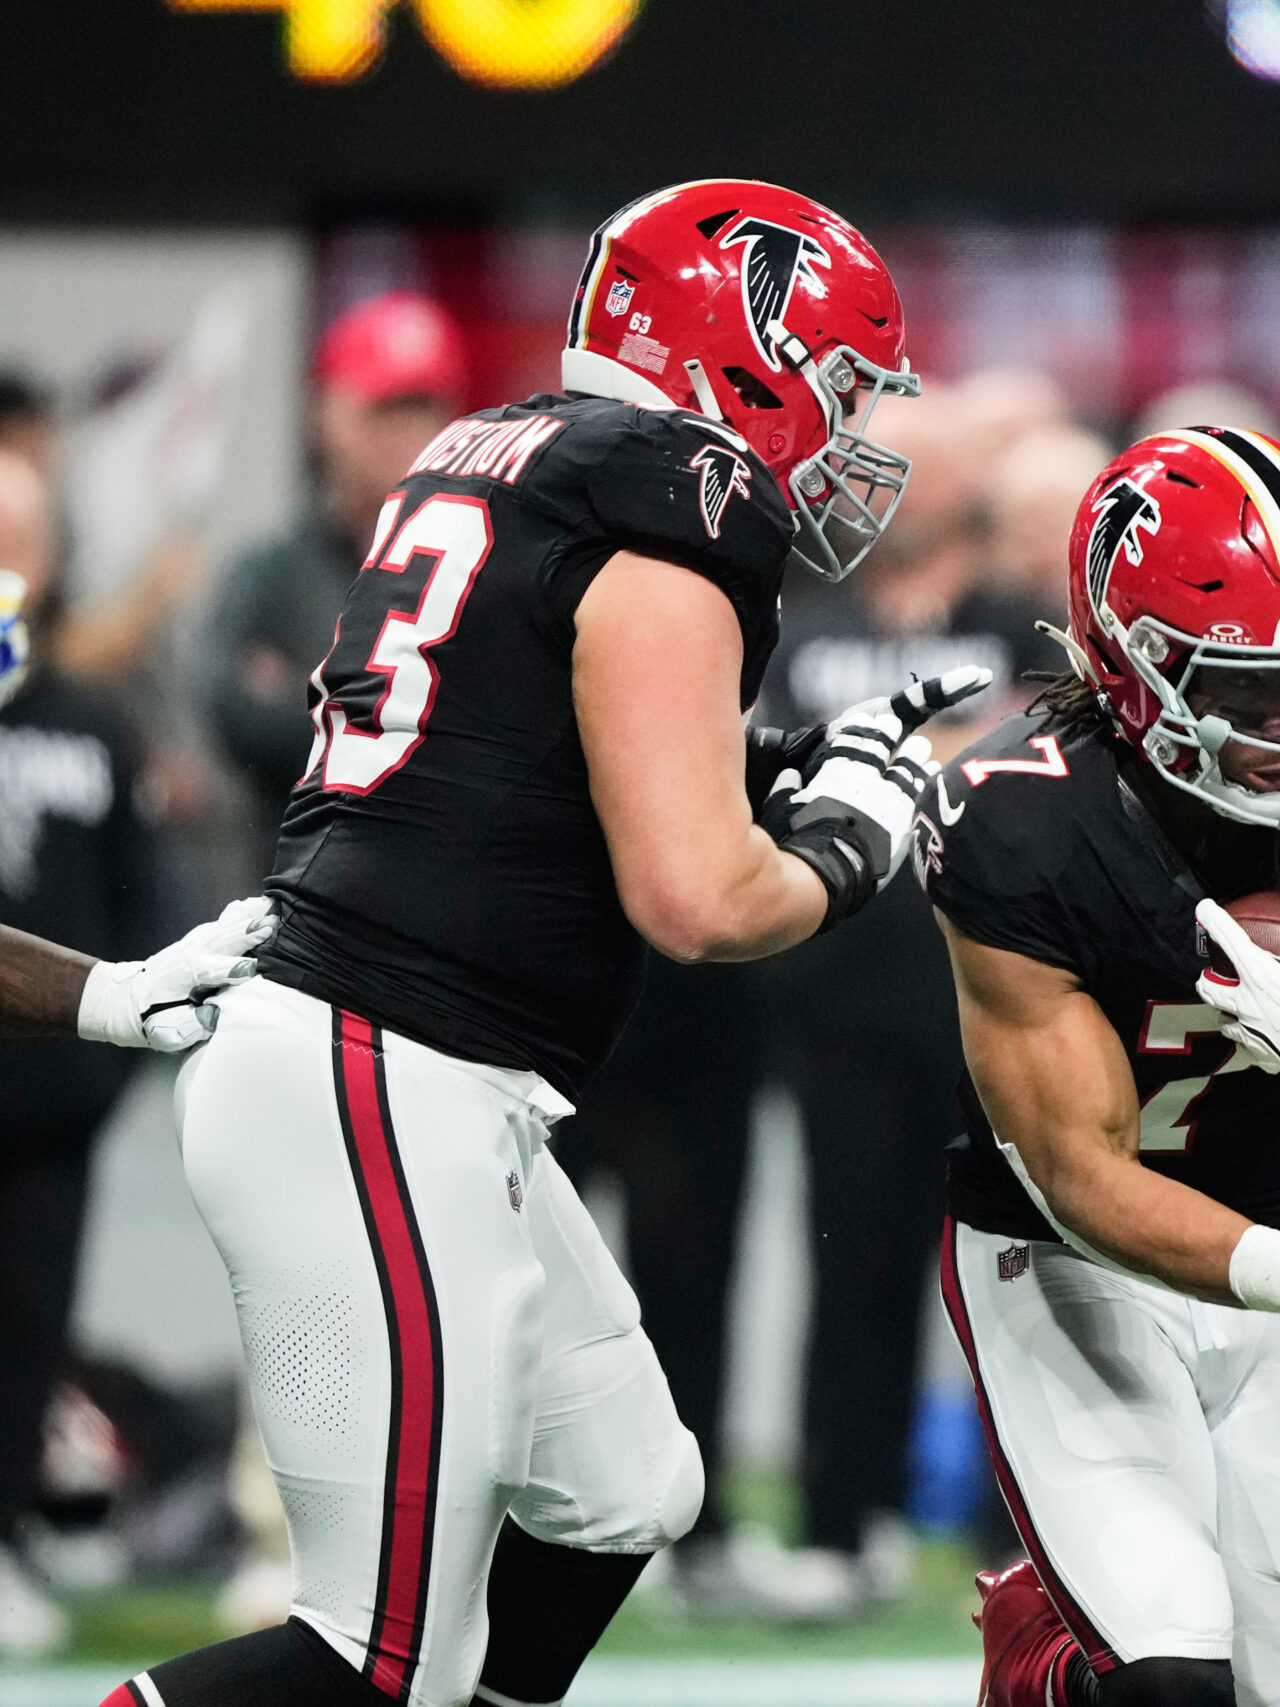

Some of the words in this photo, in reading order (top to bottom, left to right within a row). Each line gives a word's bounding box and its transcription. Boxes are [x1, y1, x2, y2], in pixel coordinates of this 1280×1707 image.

[609, 296, 625, 311] NFL
[629, 312, 652, 334] 63
[959, 734, 1072, 789] 7
[1138, 999, 1256, 1156] 7
